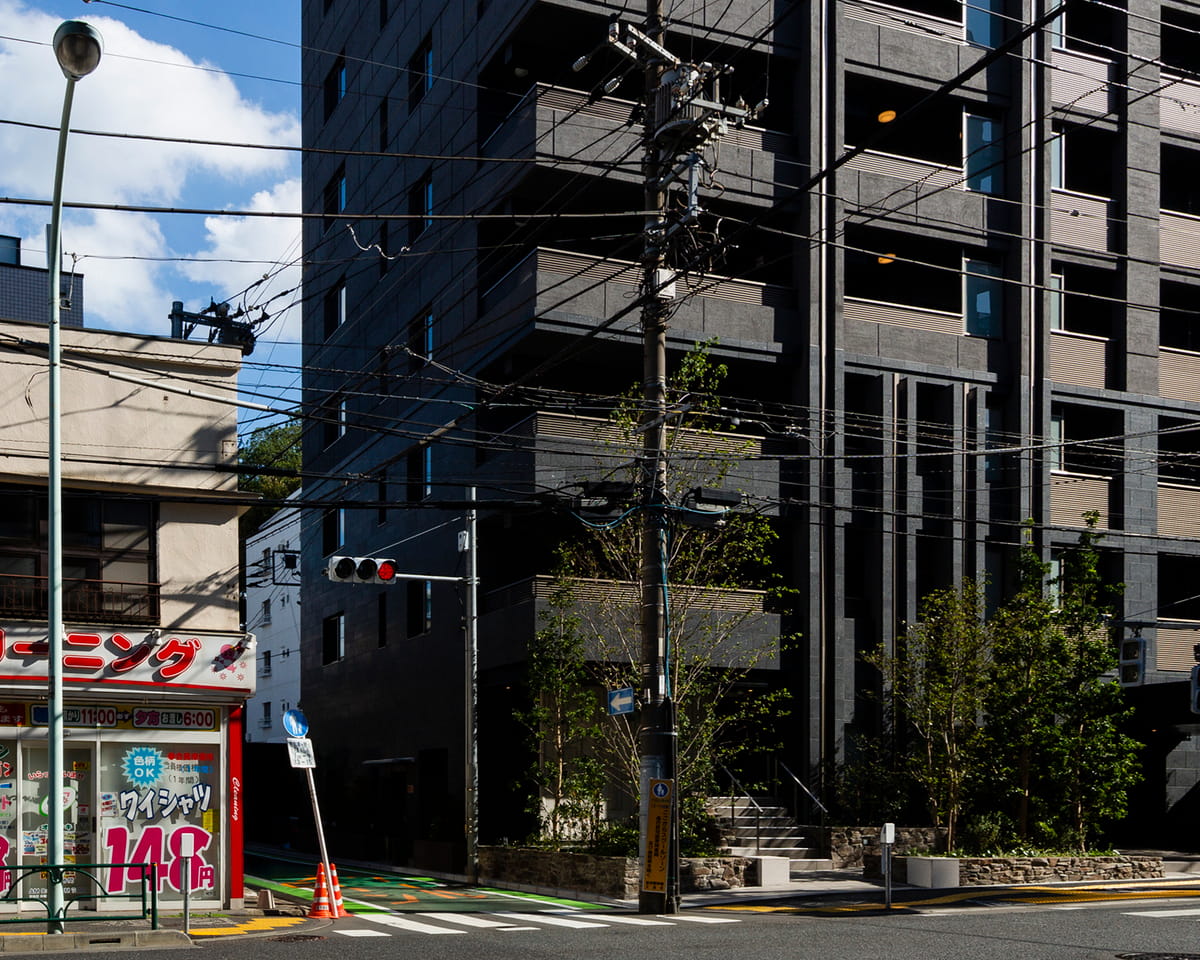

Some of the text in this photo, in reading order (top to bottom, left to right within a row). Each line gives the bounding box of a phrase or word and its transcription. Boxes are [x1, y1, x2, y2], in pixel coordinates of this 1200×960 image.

[81, 708, 116, 725] 11:00
[183, 712, 213, 728] 6:00
[133, 755, 157, 767] 色柄
[134, 768, 155, 778] OK
[119, 784, 212, 822] ワイシャツ
